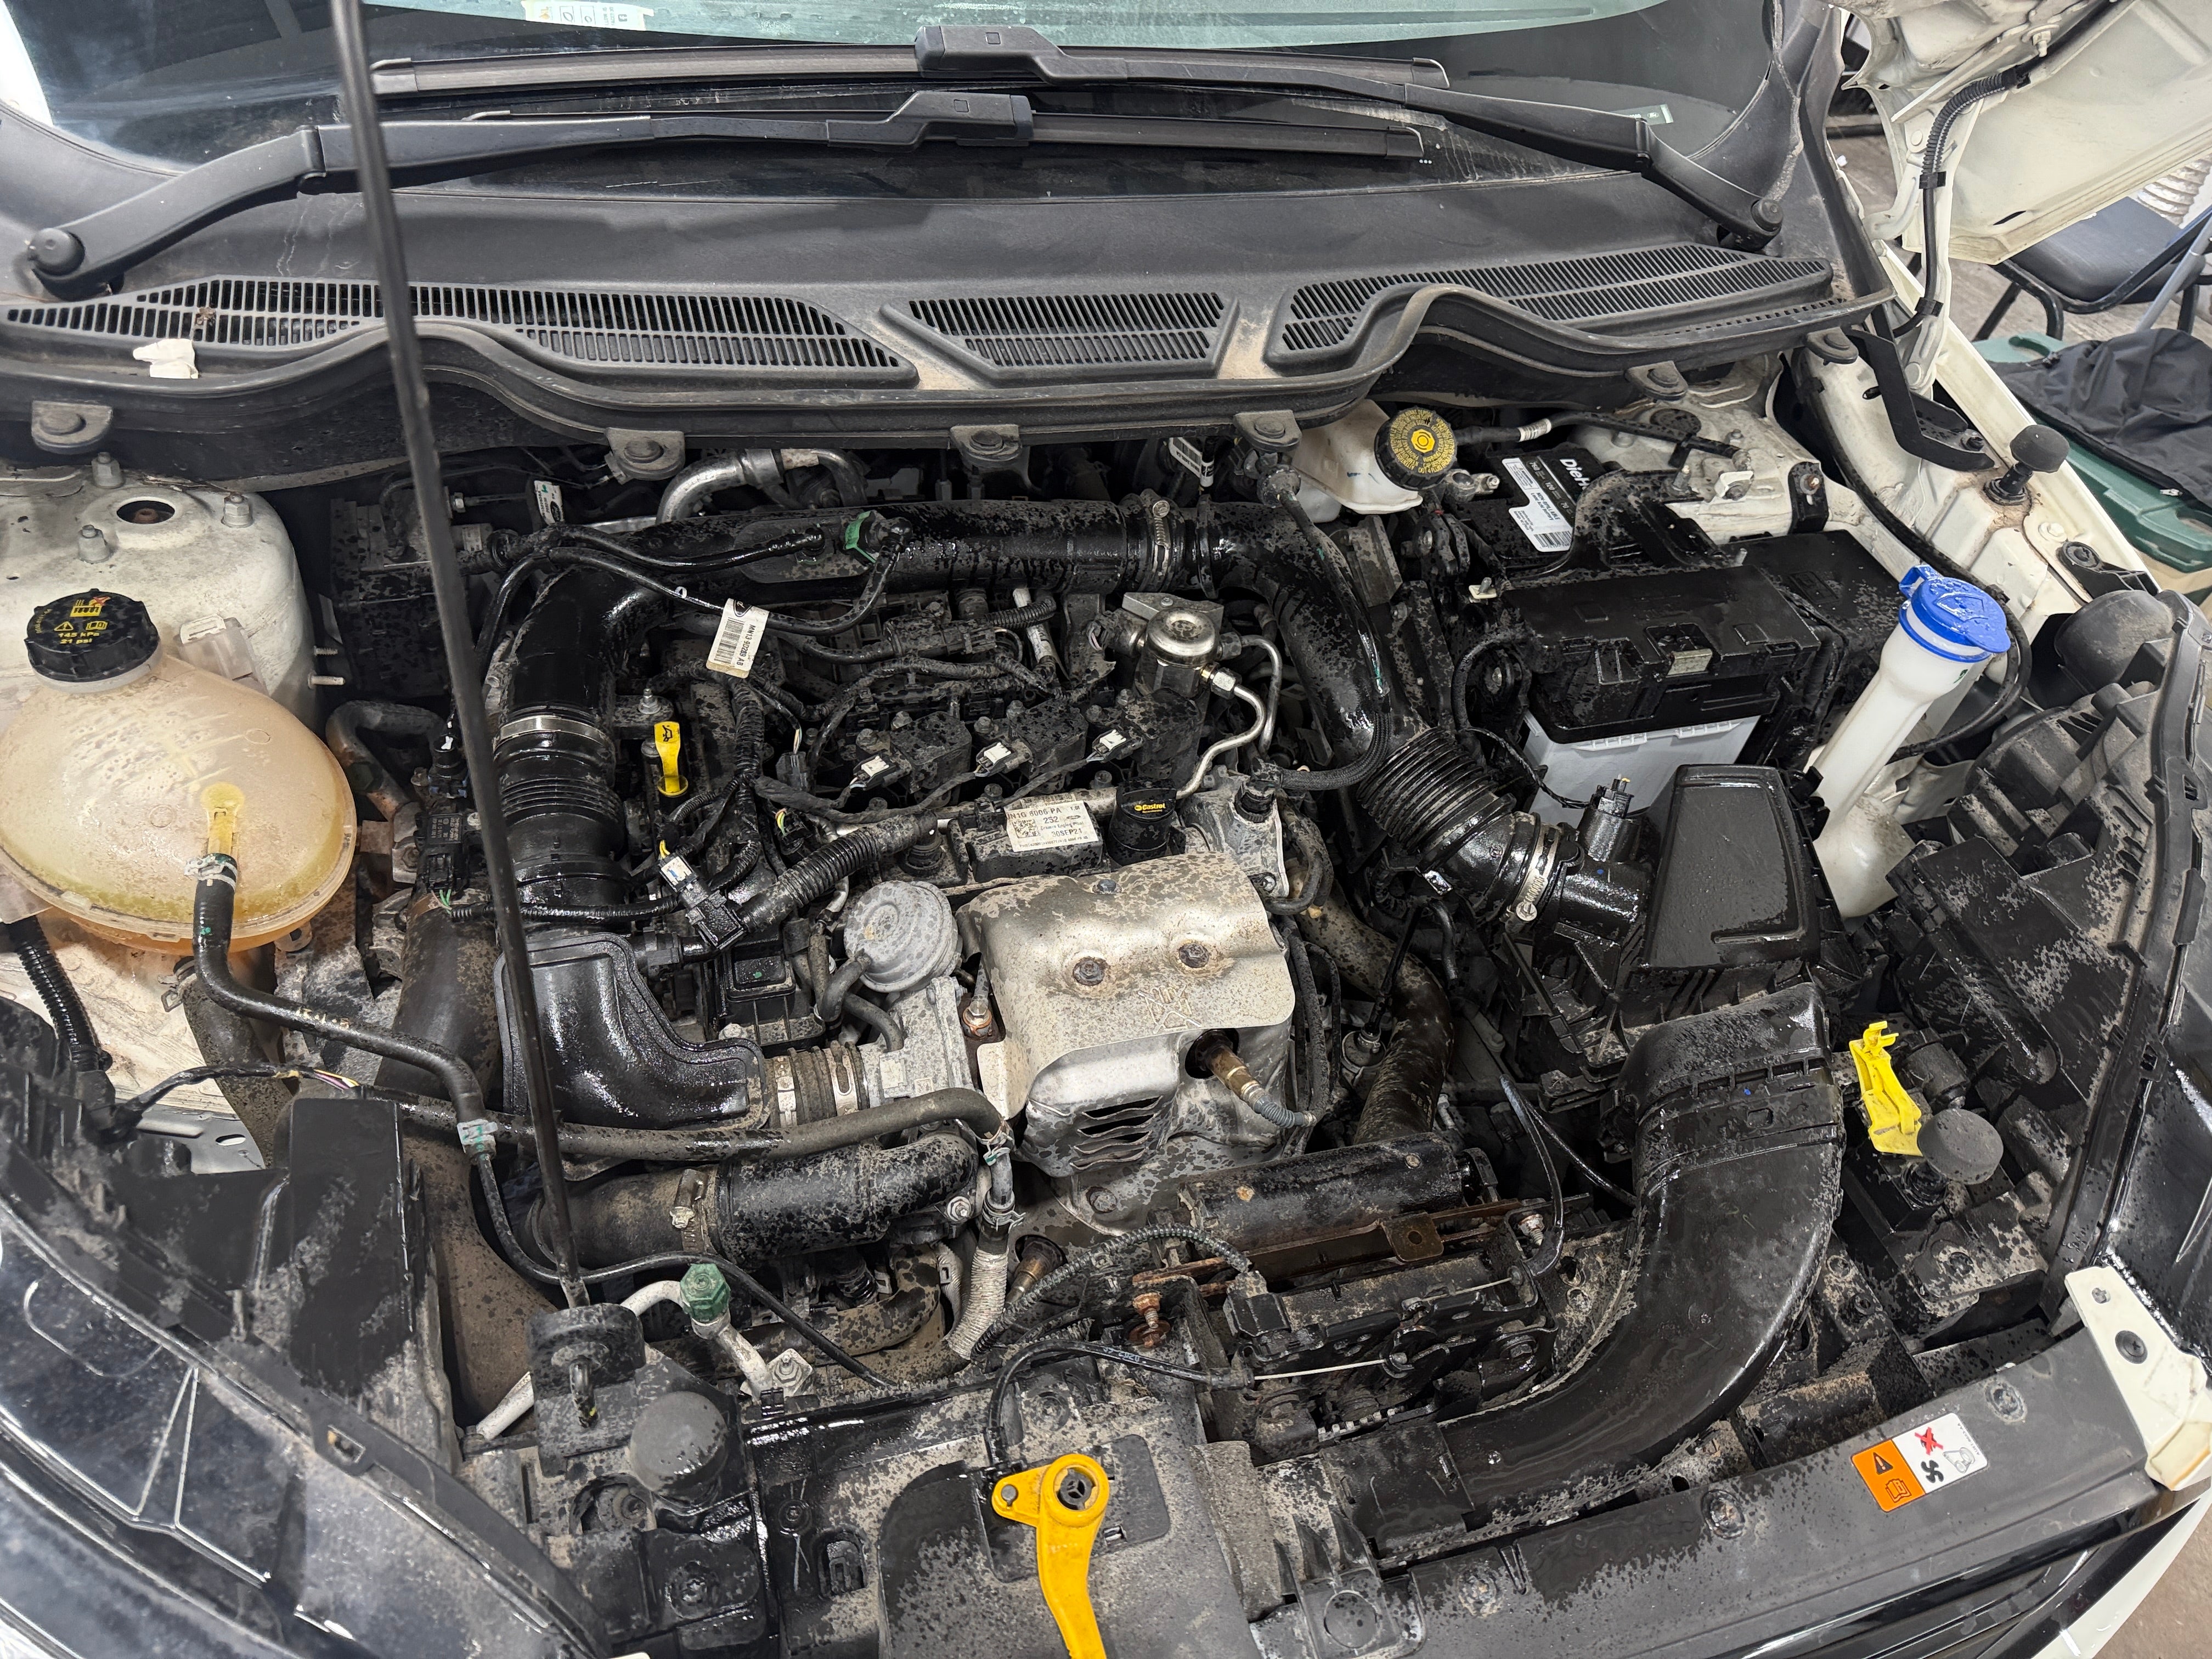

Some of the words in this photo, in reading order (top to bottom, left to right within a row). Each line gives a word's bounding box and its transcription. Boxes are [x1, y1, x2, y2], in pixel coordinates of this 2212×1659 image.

[1560, 459, 1588, 489] DieH
[1043, 816, 1059, 824] 252
[1052, 828, 1082, 837] 30SEP21
